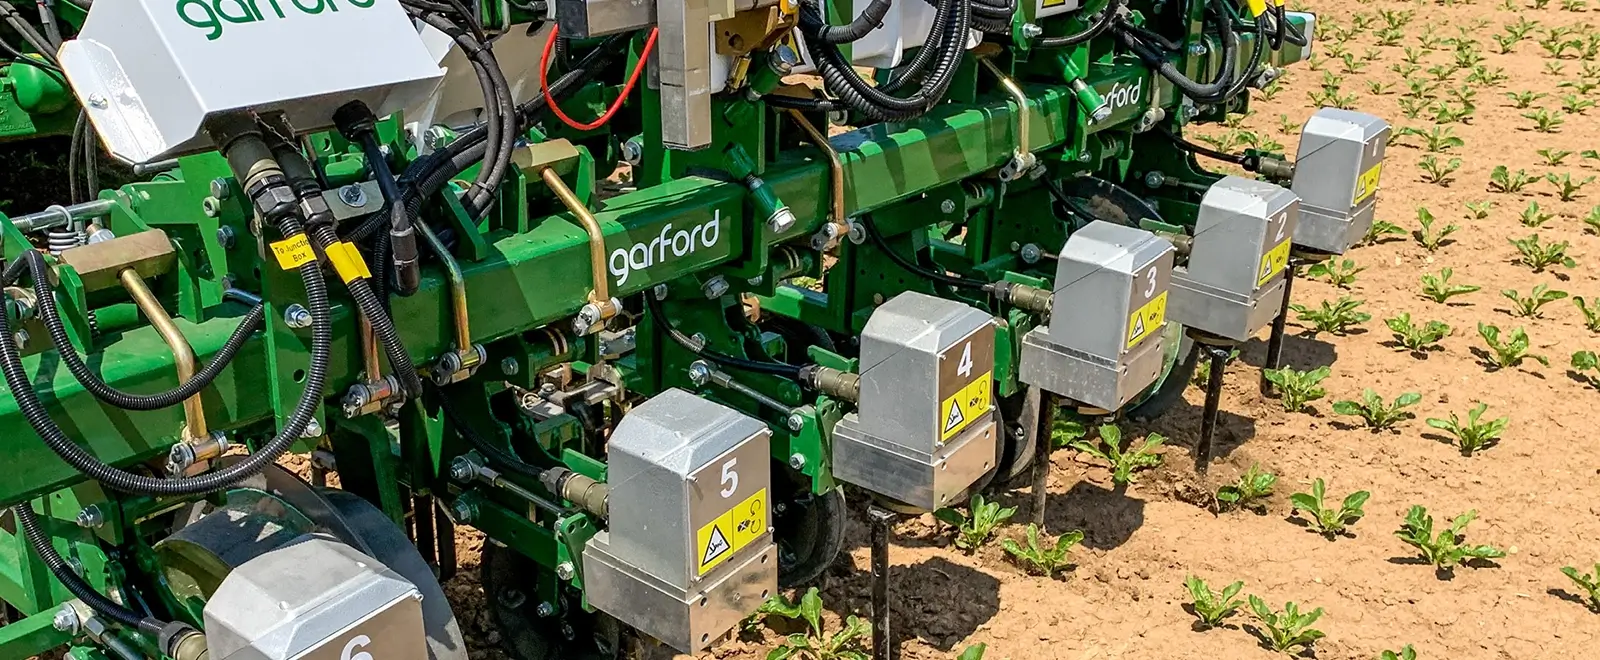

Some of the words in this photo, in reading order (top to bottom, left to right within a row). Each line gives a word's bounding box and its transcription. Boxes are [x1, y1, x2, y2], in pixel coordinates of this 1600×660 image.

[176, 0, 375, 41] garo
[1100, 76, 1143, 110] rford
[1372, 137, 1380, 157] 1
[1274, 211, 1288, 243] 2
[274, 246, 285, 255] To
[292, 252, 307, 262] Box
[608, 208, 720, 287] garford
[1144, 265, 1158, 299] 3
[957, 340, 974, 378] 4
[720, 457, 739, 498] 5
[340, 634, 374, 660] 6
